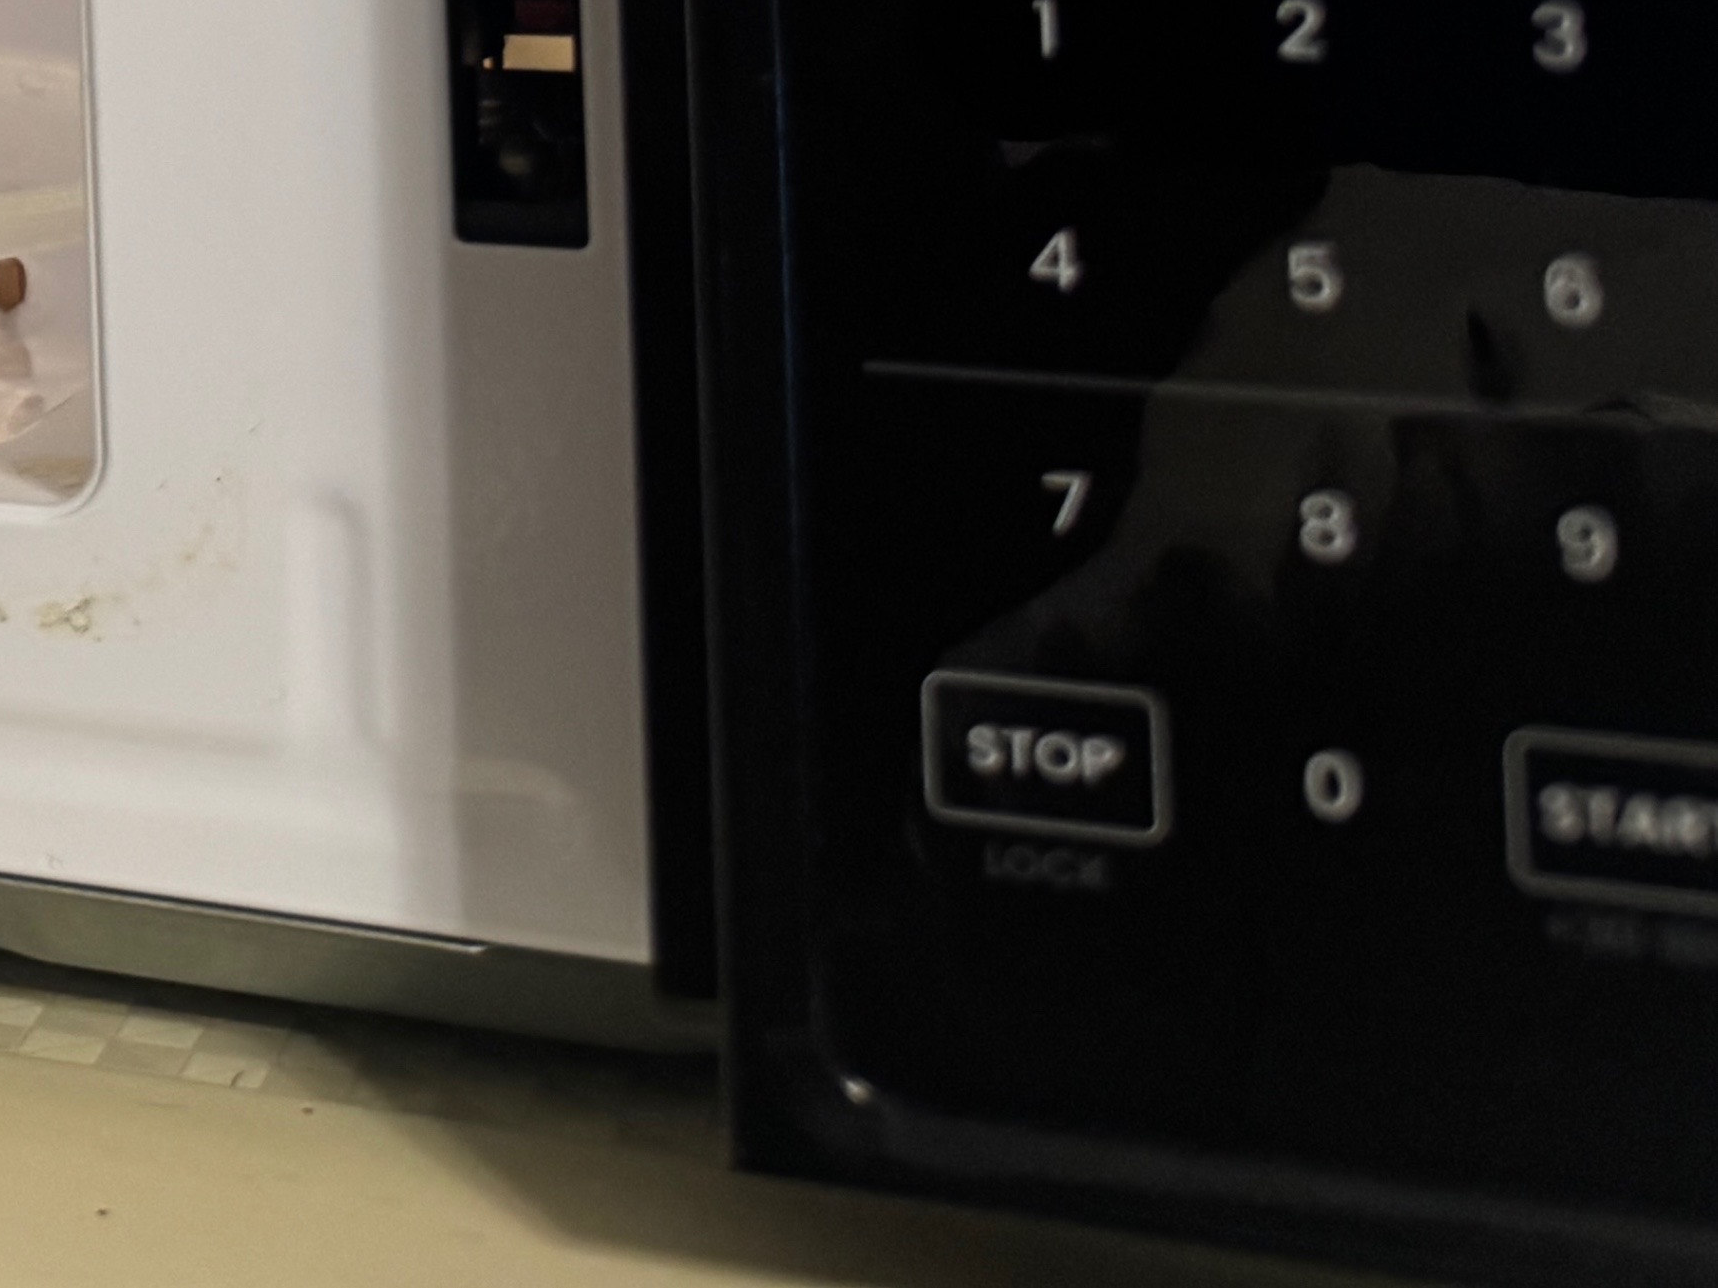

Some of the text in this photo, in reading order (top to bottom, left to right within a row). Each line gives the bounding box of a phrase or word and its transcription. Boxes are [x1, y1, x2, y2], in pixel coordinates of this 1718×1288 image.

[1028, 225, 1084, 294] 4
[1287, 240, 1343, 313] 5
[1543, 251, 1603, 327] 6
[1040, 469, 1093, 537] 7
[1298, 488, 1358, 565] 8
[1556, 503, 1619, 584] 9
[965, 723, 1126, 787] STOP
[1302, 746, 1362, 824] 0
[1536, 781, 1718, 859] STAR
[984, 842, 1111, 893] LOCK
